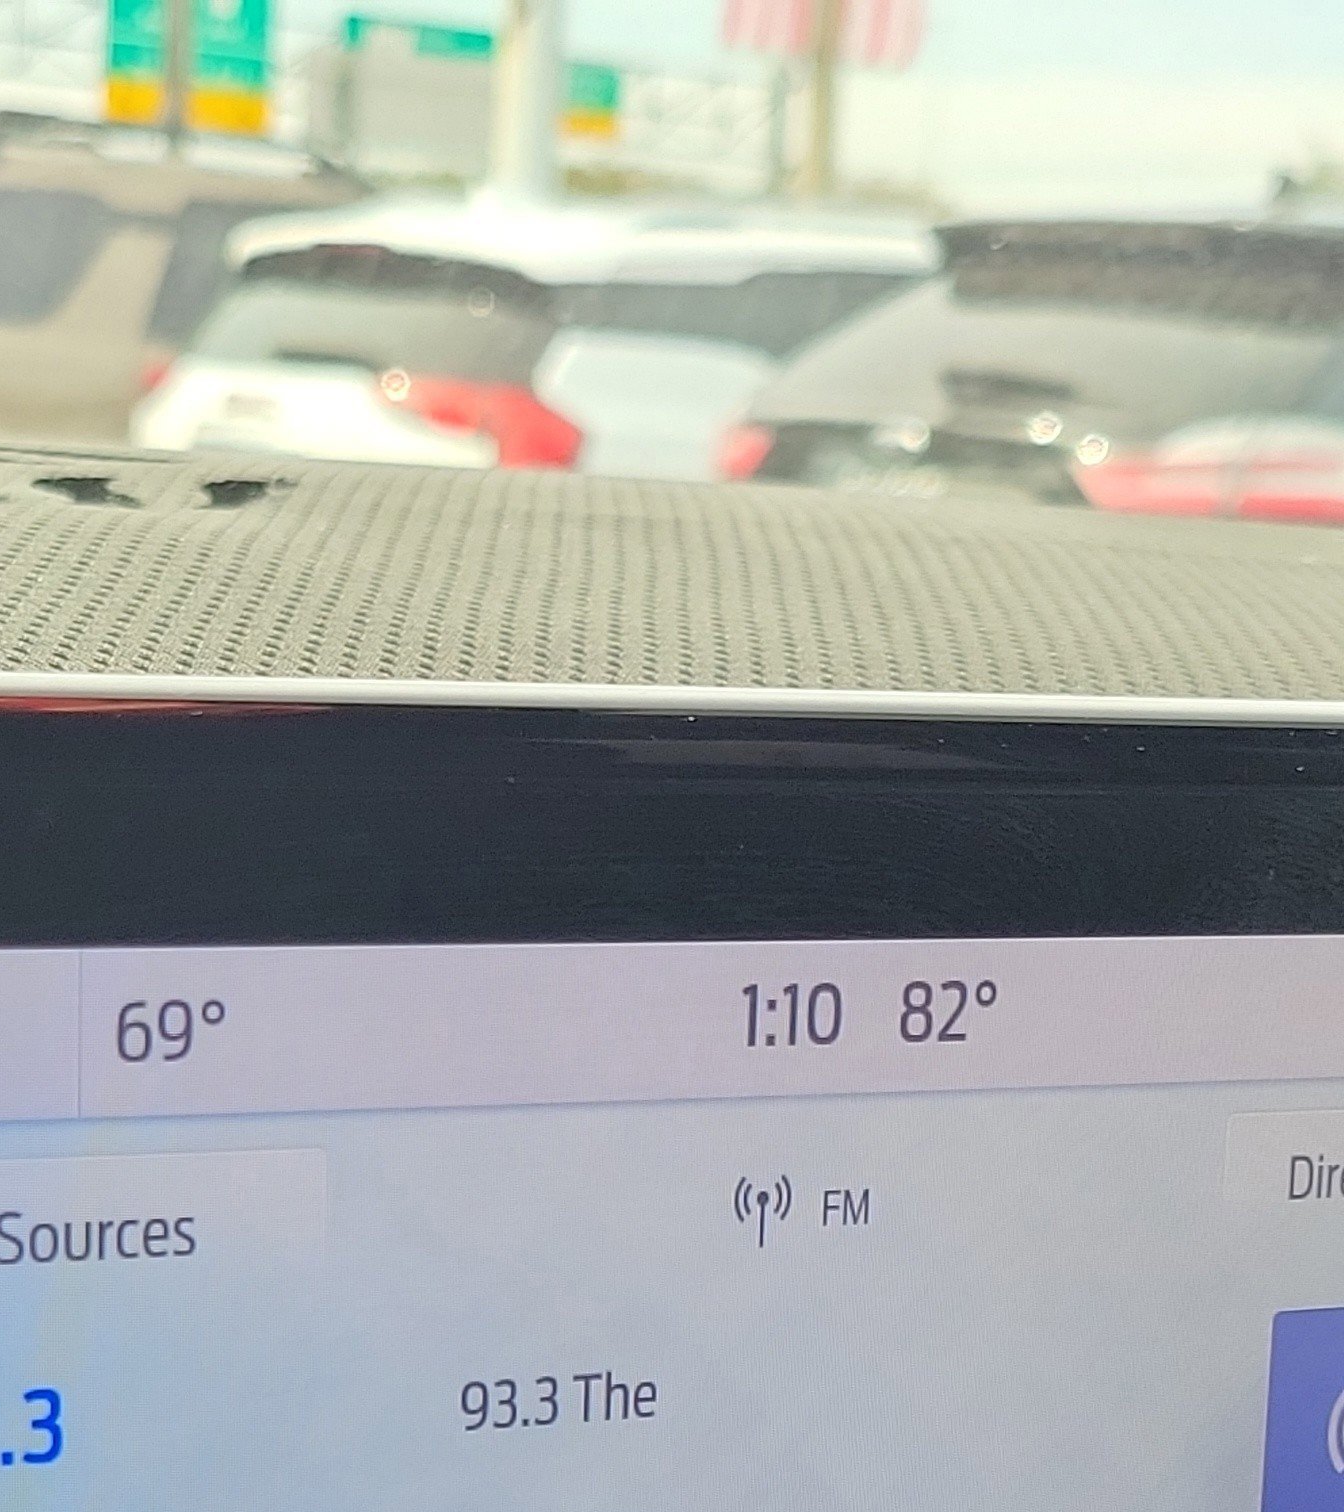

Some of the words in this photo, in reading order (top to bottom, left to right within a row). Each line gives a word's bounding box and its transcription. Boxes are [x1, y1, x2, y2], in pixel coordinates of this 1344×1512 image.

[115, 998, 227, 1063] 69°
[740, 981, 844, 1048] 1:10
[898, 979, 998, 1044] 82°
[821, 1189, 871, 1227] FM
[459, 1376, 560, 1431] 93.3
[573, 1370, 658, 1424] The
